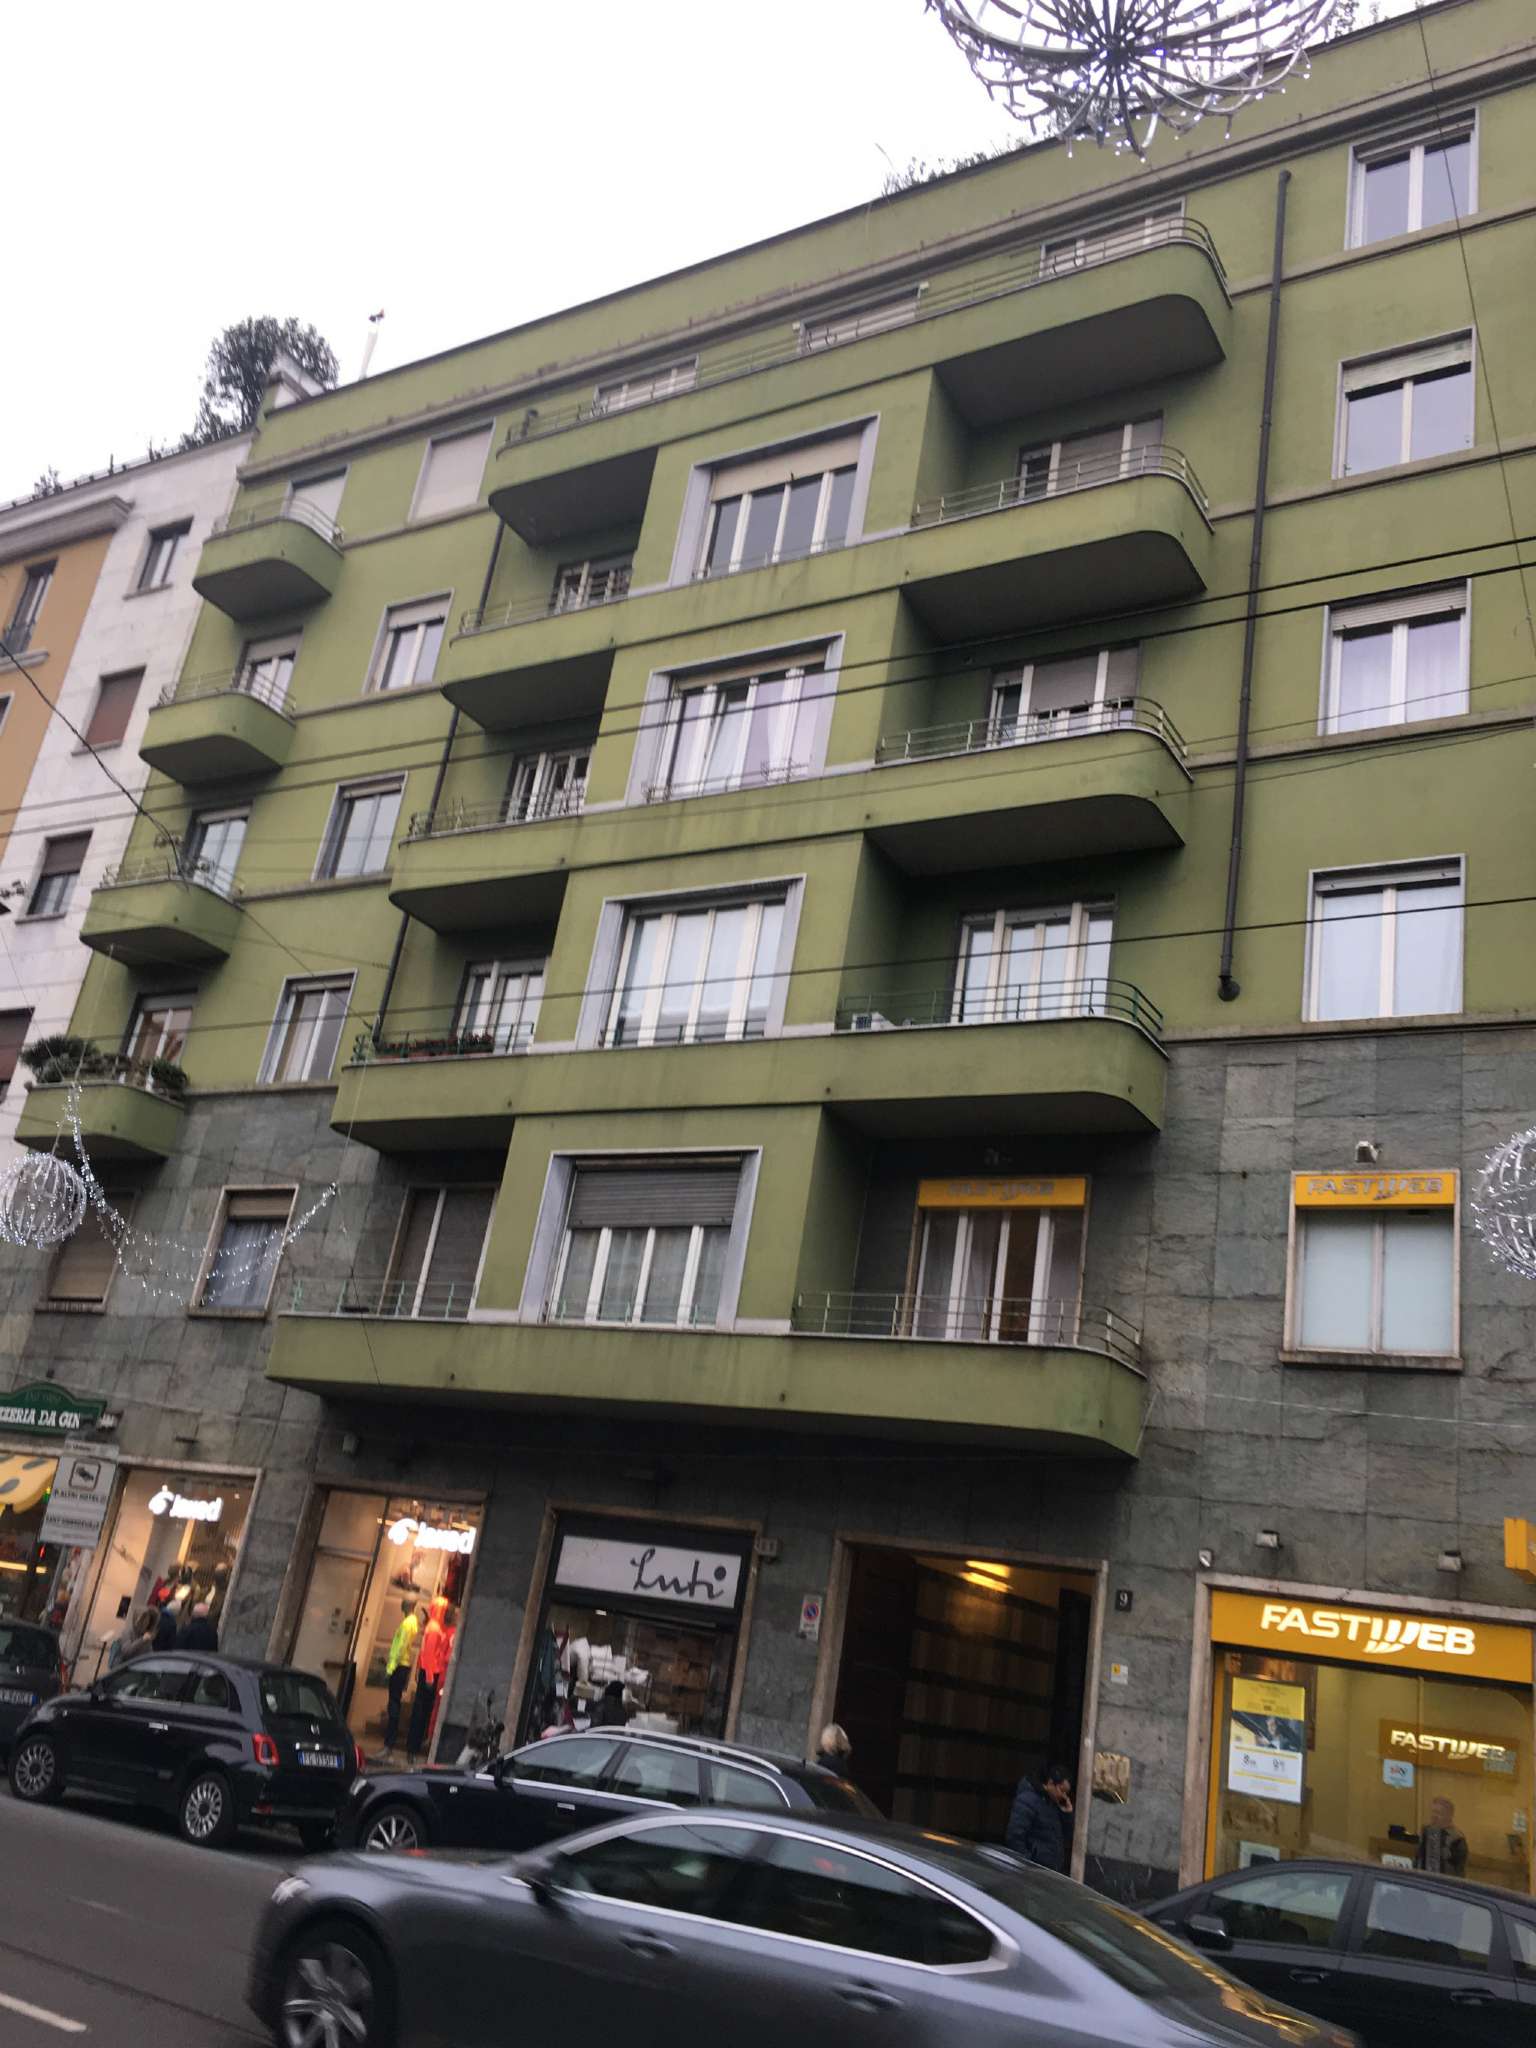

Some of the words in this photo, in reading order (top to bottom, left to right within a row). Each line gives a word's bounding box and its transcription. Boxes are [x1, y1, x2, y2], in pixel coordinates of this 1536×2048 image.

[1308, 1178, 1443, 1200] FASTWEB
[38, 1410, 57, 1428] DA
[58, 1411, 81, 1430] GIN
[1119, 1592, 1128, 1607] 9
[1260, 1604, 1476, 1655] FASTWEB
[1390, 1729, 1506, 1761] FASTWEB
